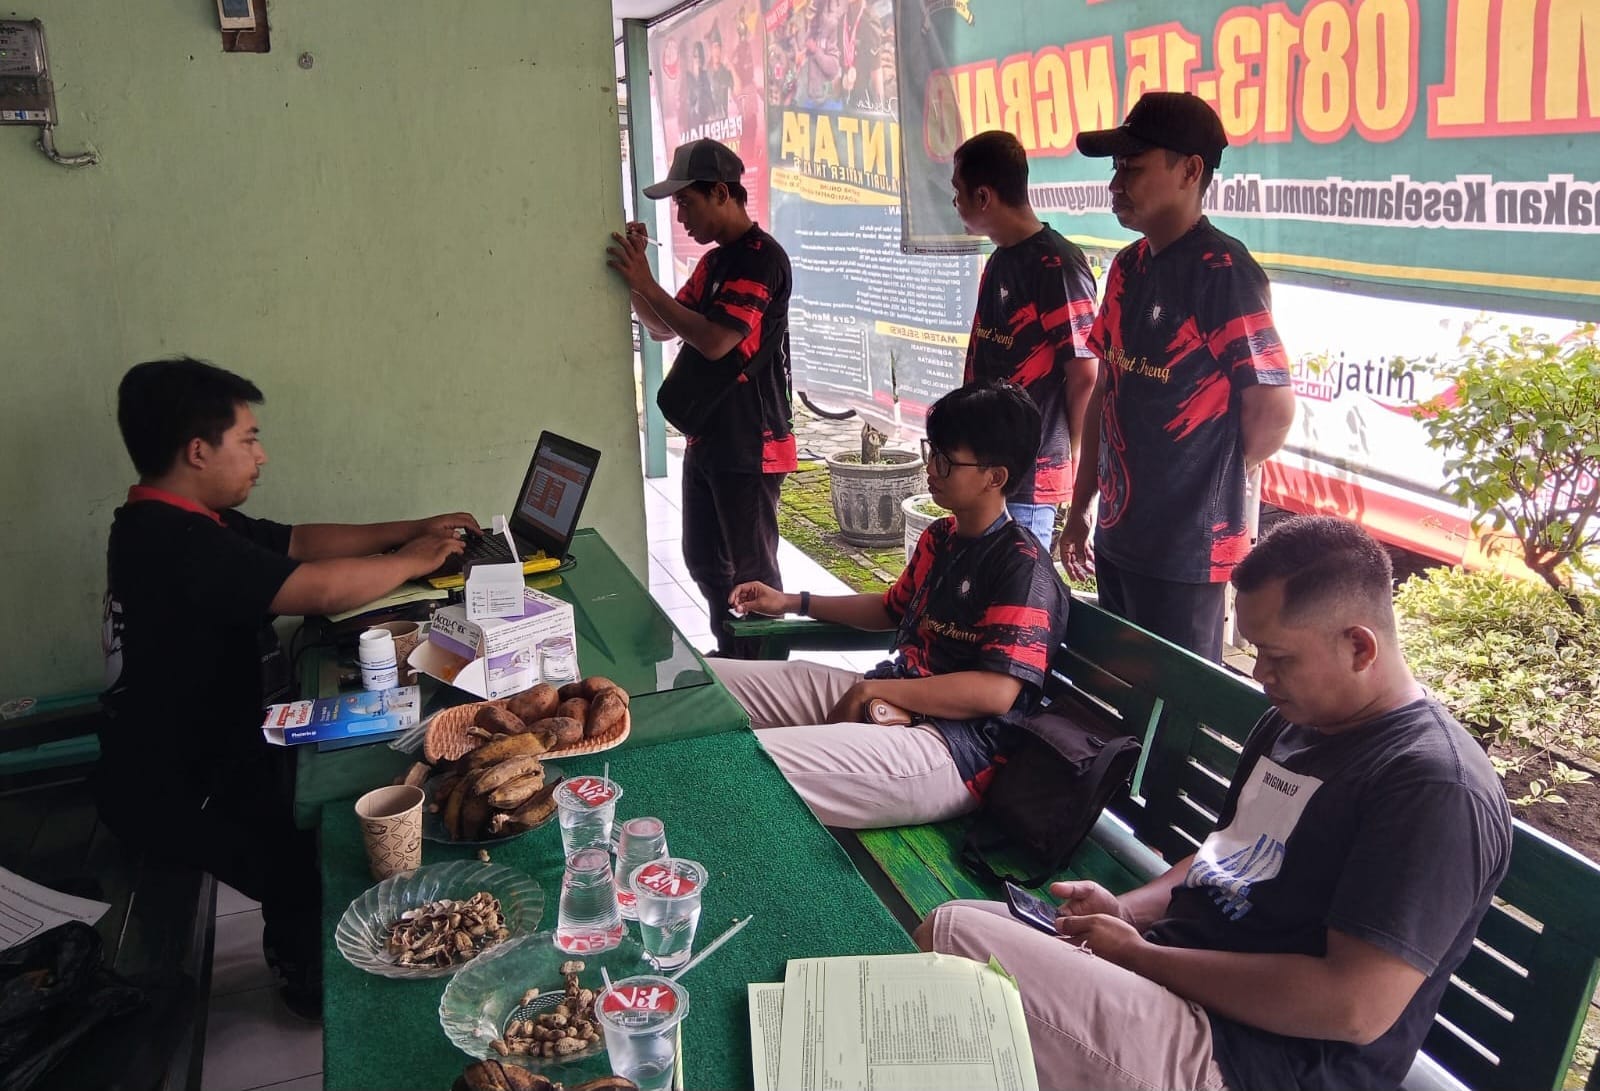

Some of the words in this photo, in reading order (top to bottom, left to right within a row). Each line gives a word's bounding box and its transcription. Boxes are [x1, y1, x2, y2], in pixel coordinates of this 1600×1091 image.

[577, 779, 611, 801] Vit
[638, 872, 681, 896] Vit
[612, 986, 669, 1010] Vit
